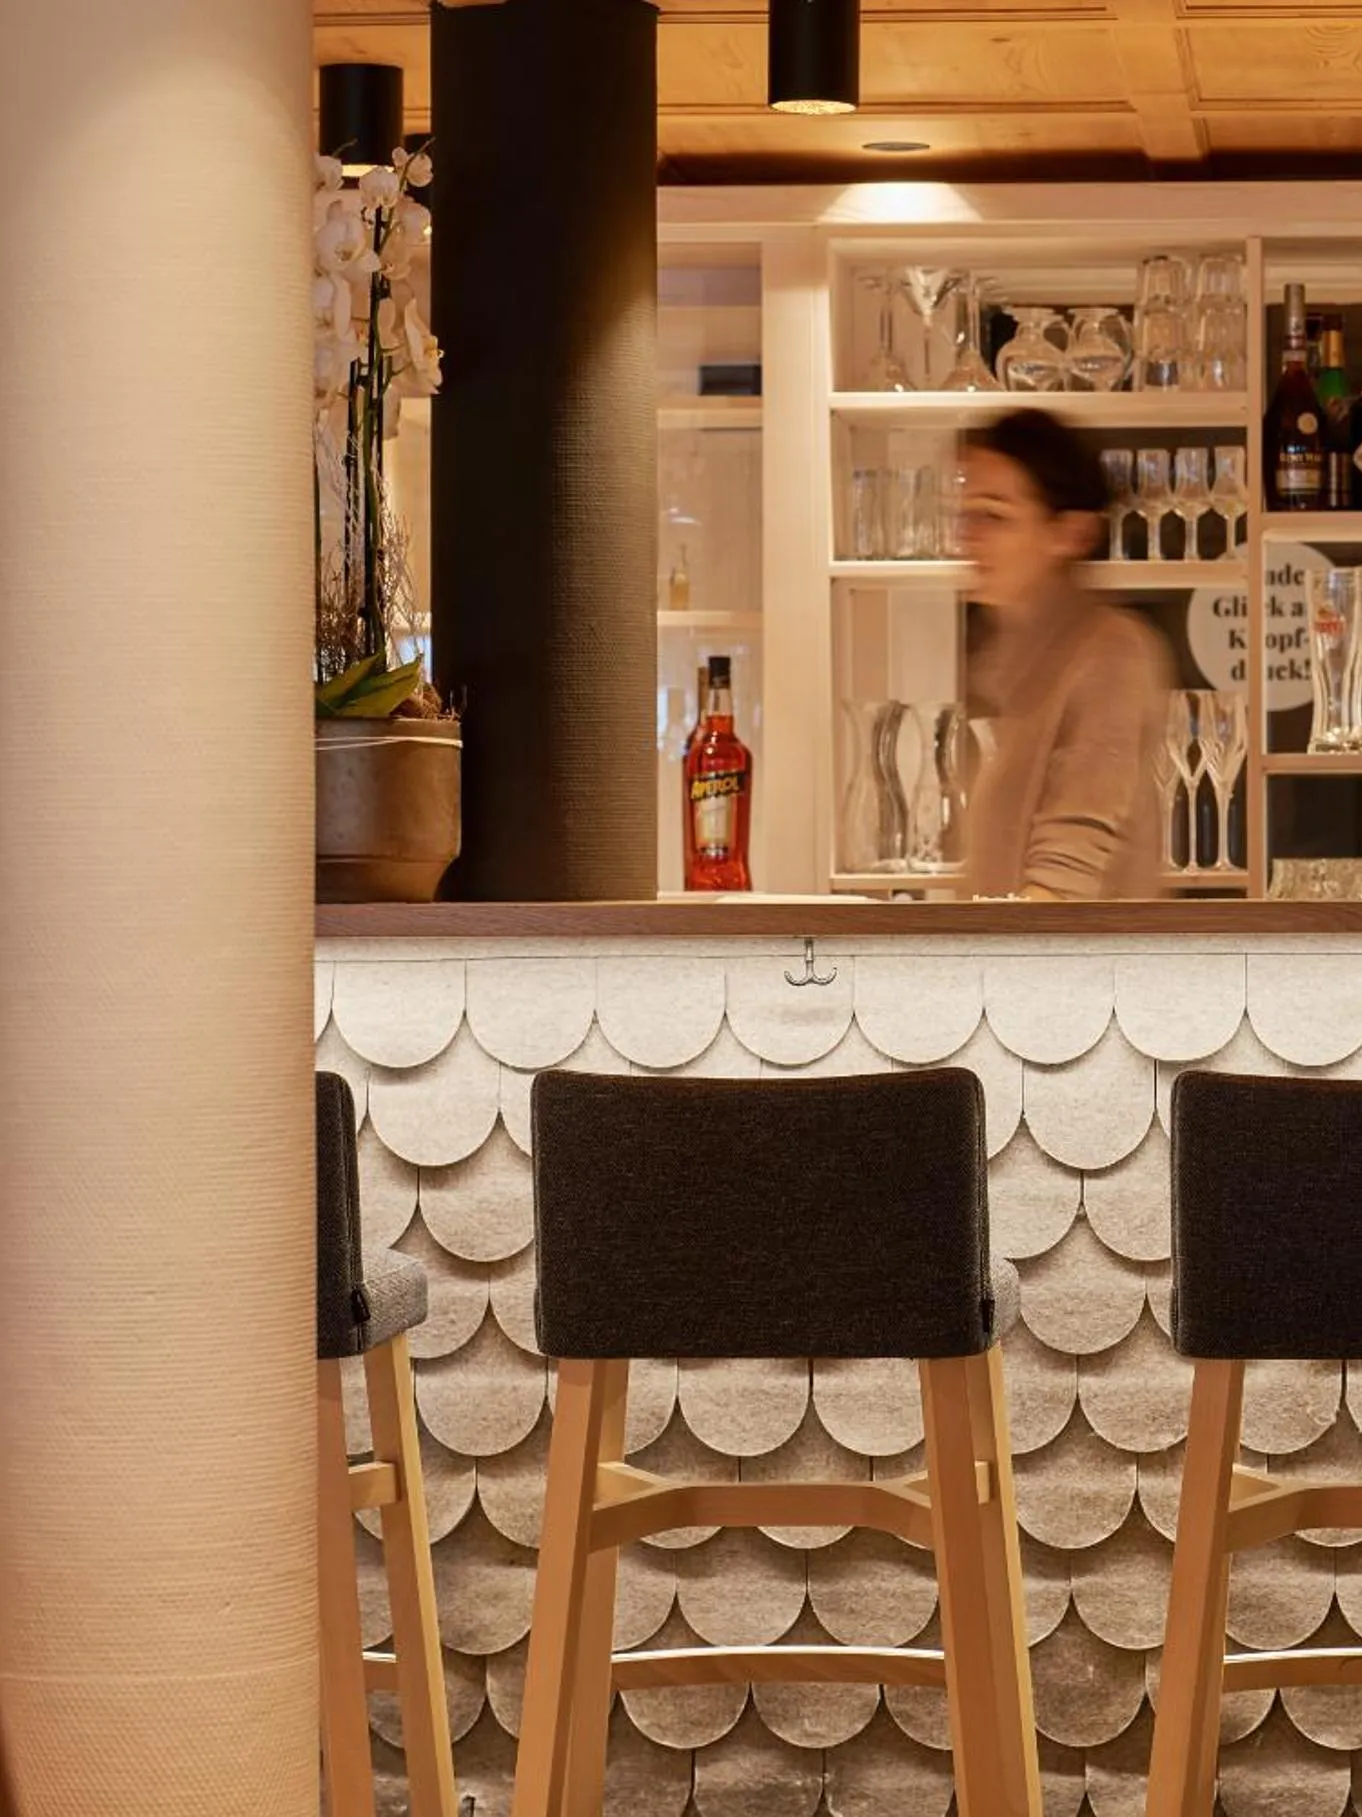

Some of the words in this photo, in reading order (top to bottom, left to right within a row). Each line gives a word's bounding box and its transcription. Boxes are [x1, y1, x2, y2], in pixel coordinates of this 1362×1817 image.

[1213, 595, 1283, 618] Glk
[1229, 627, 1310, 653] Kopf-
[1231, 659, 1312, 681] dck!
[691, 775, 741, 800] APEROL
